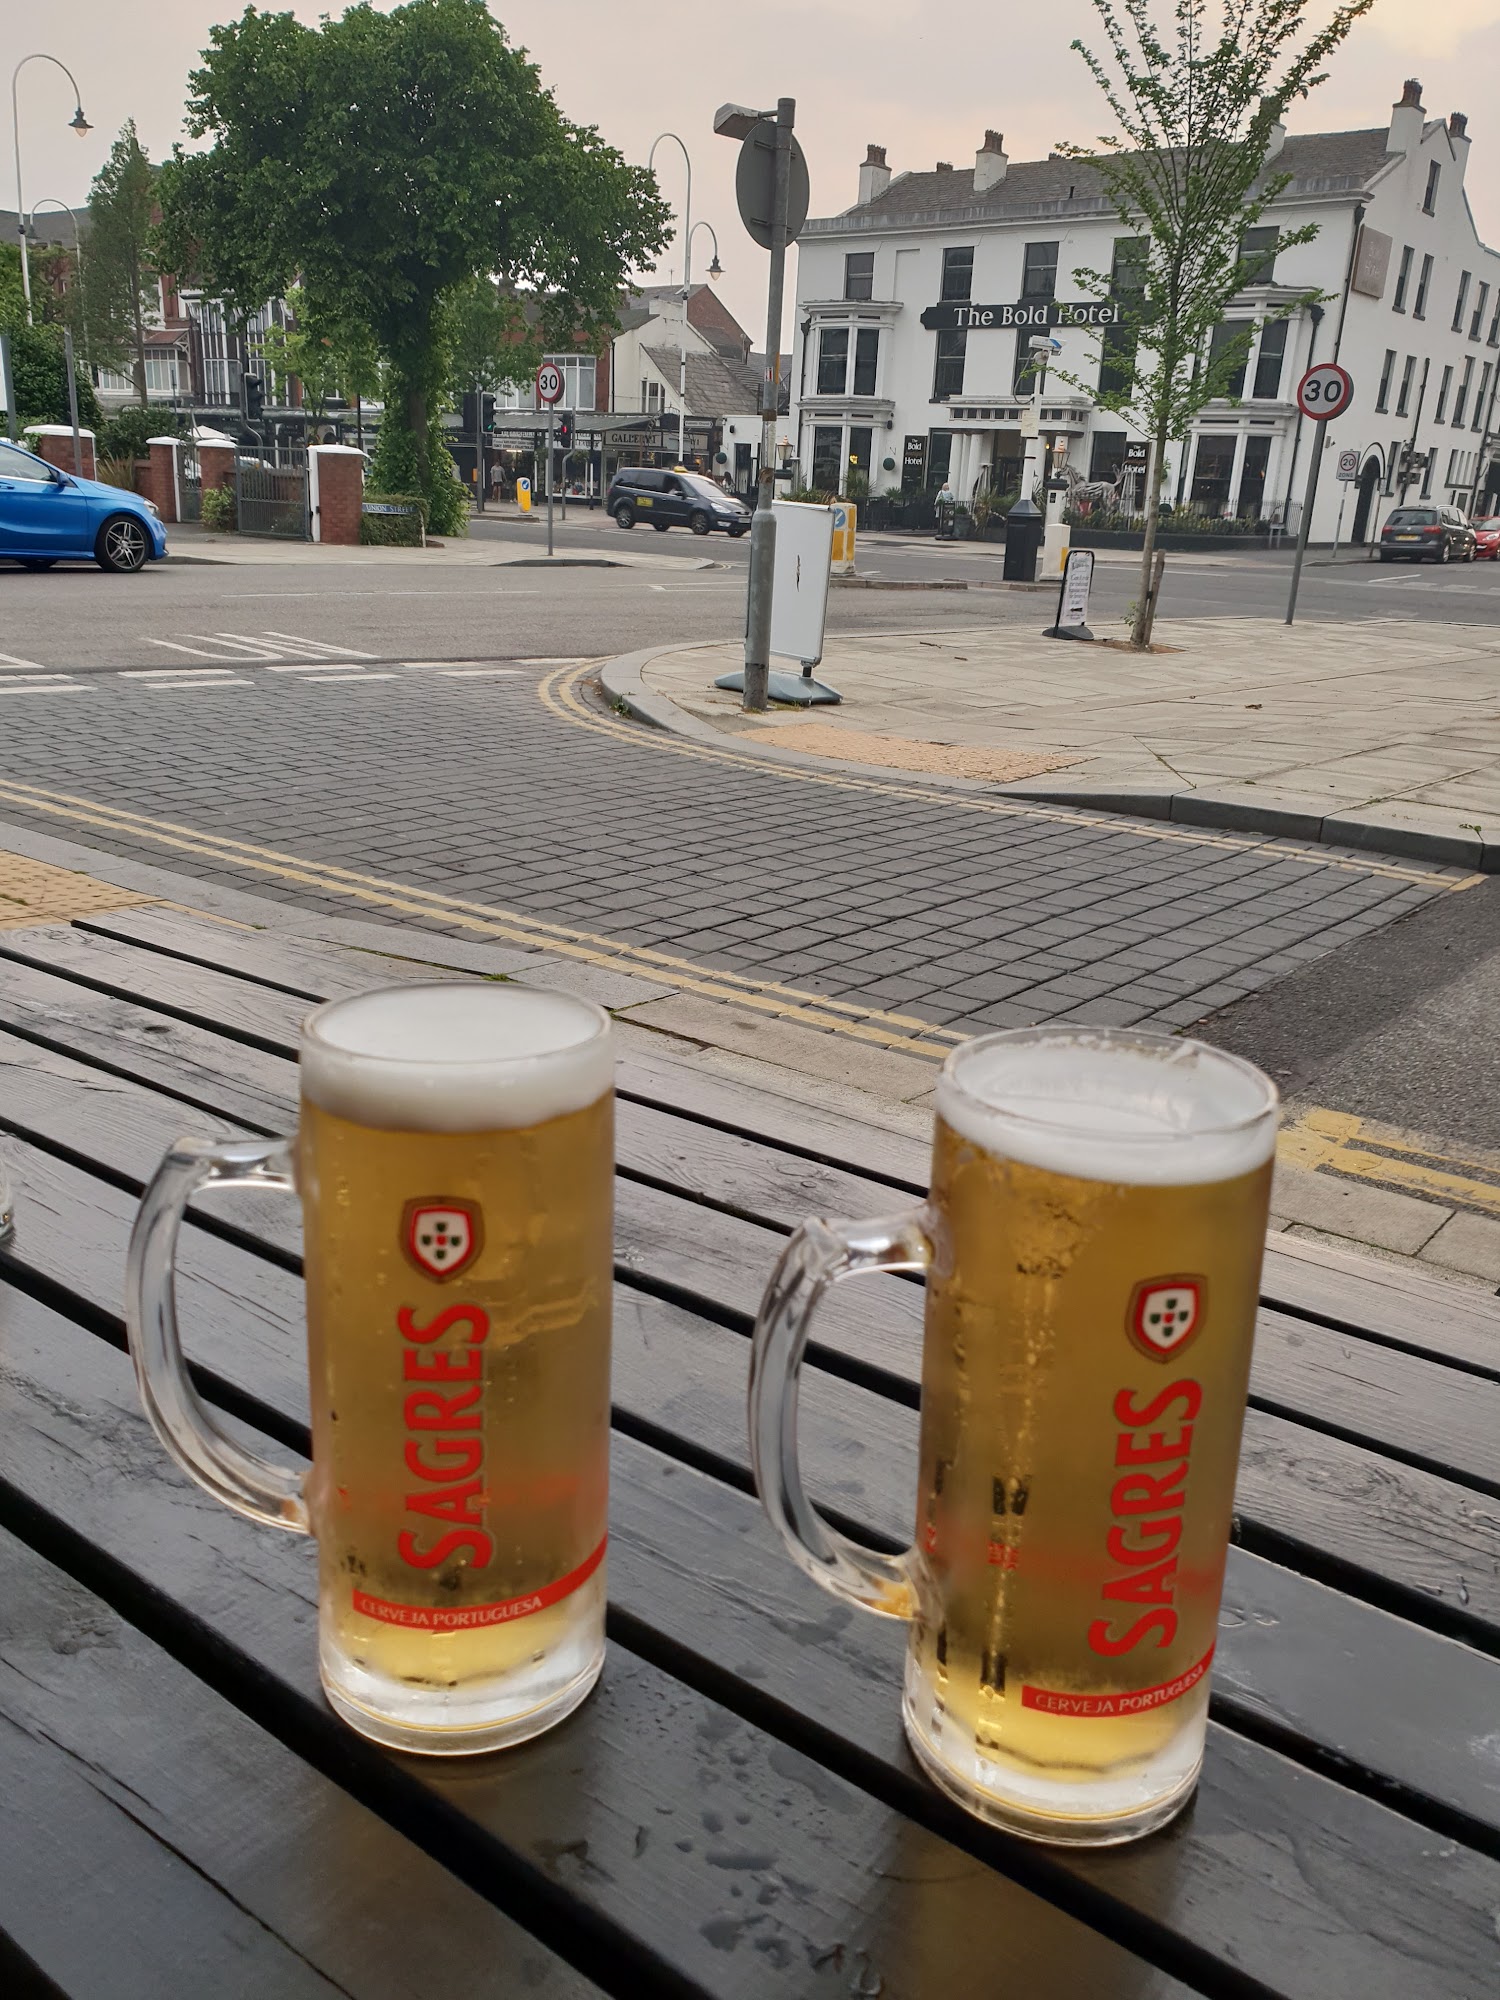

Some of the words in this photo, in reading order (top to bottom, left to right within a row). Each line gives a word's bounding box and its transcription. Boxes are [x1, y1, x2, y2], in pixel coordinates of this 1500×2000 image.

[954, 307, 994, 326] The
[1001, 305, 1048, 326] Bold
[1056, 304, 1119, 325] Hotel
[540, 374, 558, 391] 30
[1304, 379, 1342, 403] 30
[907, 442, 922, 450] Bold
[1128, 448, 1146, 457] Bold
[904, 456, 923, 465] Hotel
[1124, 464, 1146, 474] Hotel
[1342, 458, 1355, 467] 20
[397, 1303, 492, 1569] SAGRES
[1087, 1379, 1202, 1656] SAGRES
[361, 1598, 429, 1626] CERVEJA
[432, 1596, 542, 1627] PORTUGUESA
[1036, 1693, 1114, 1713] CERVEJA
